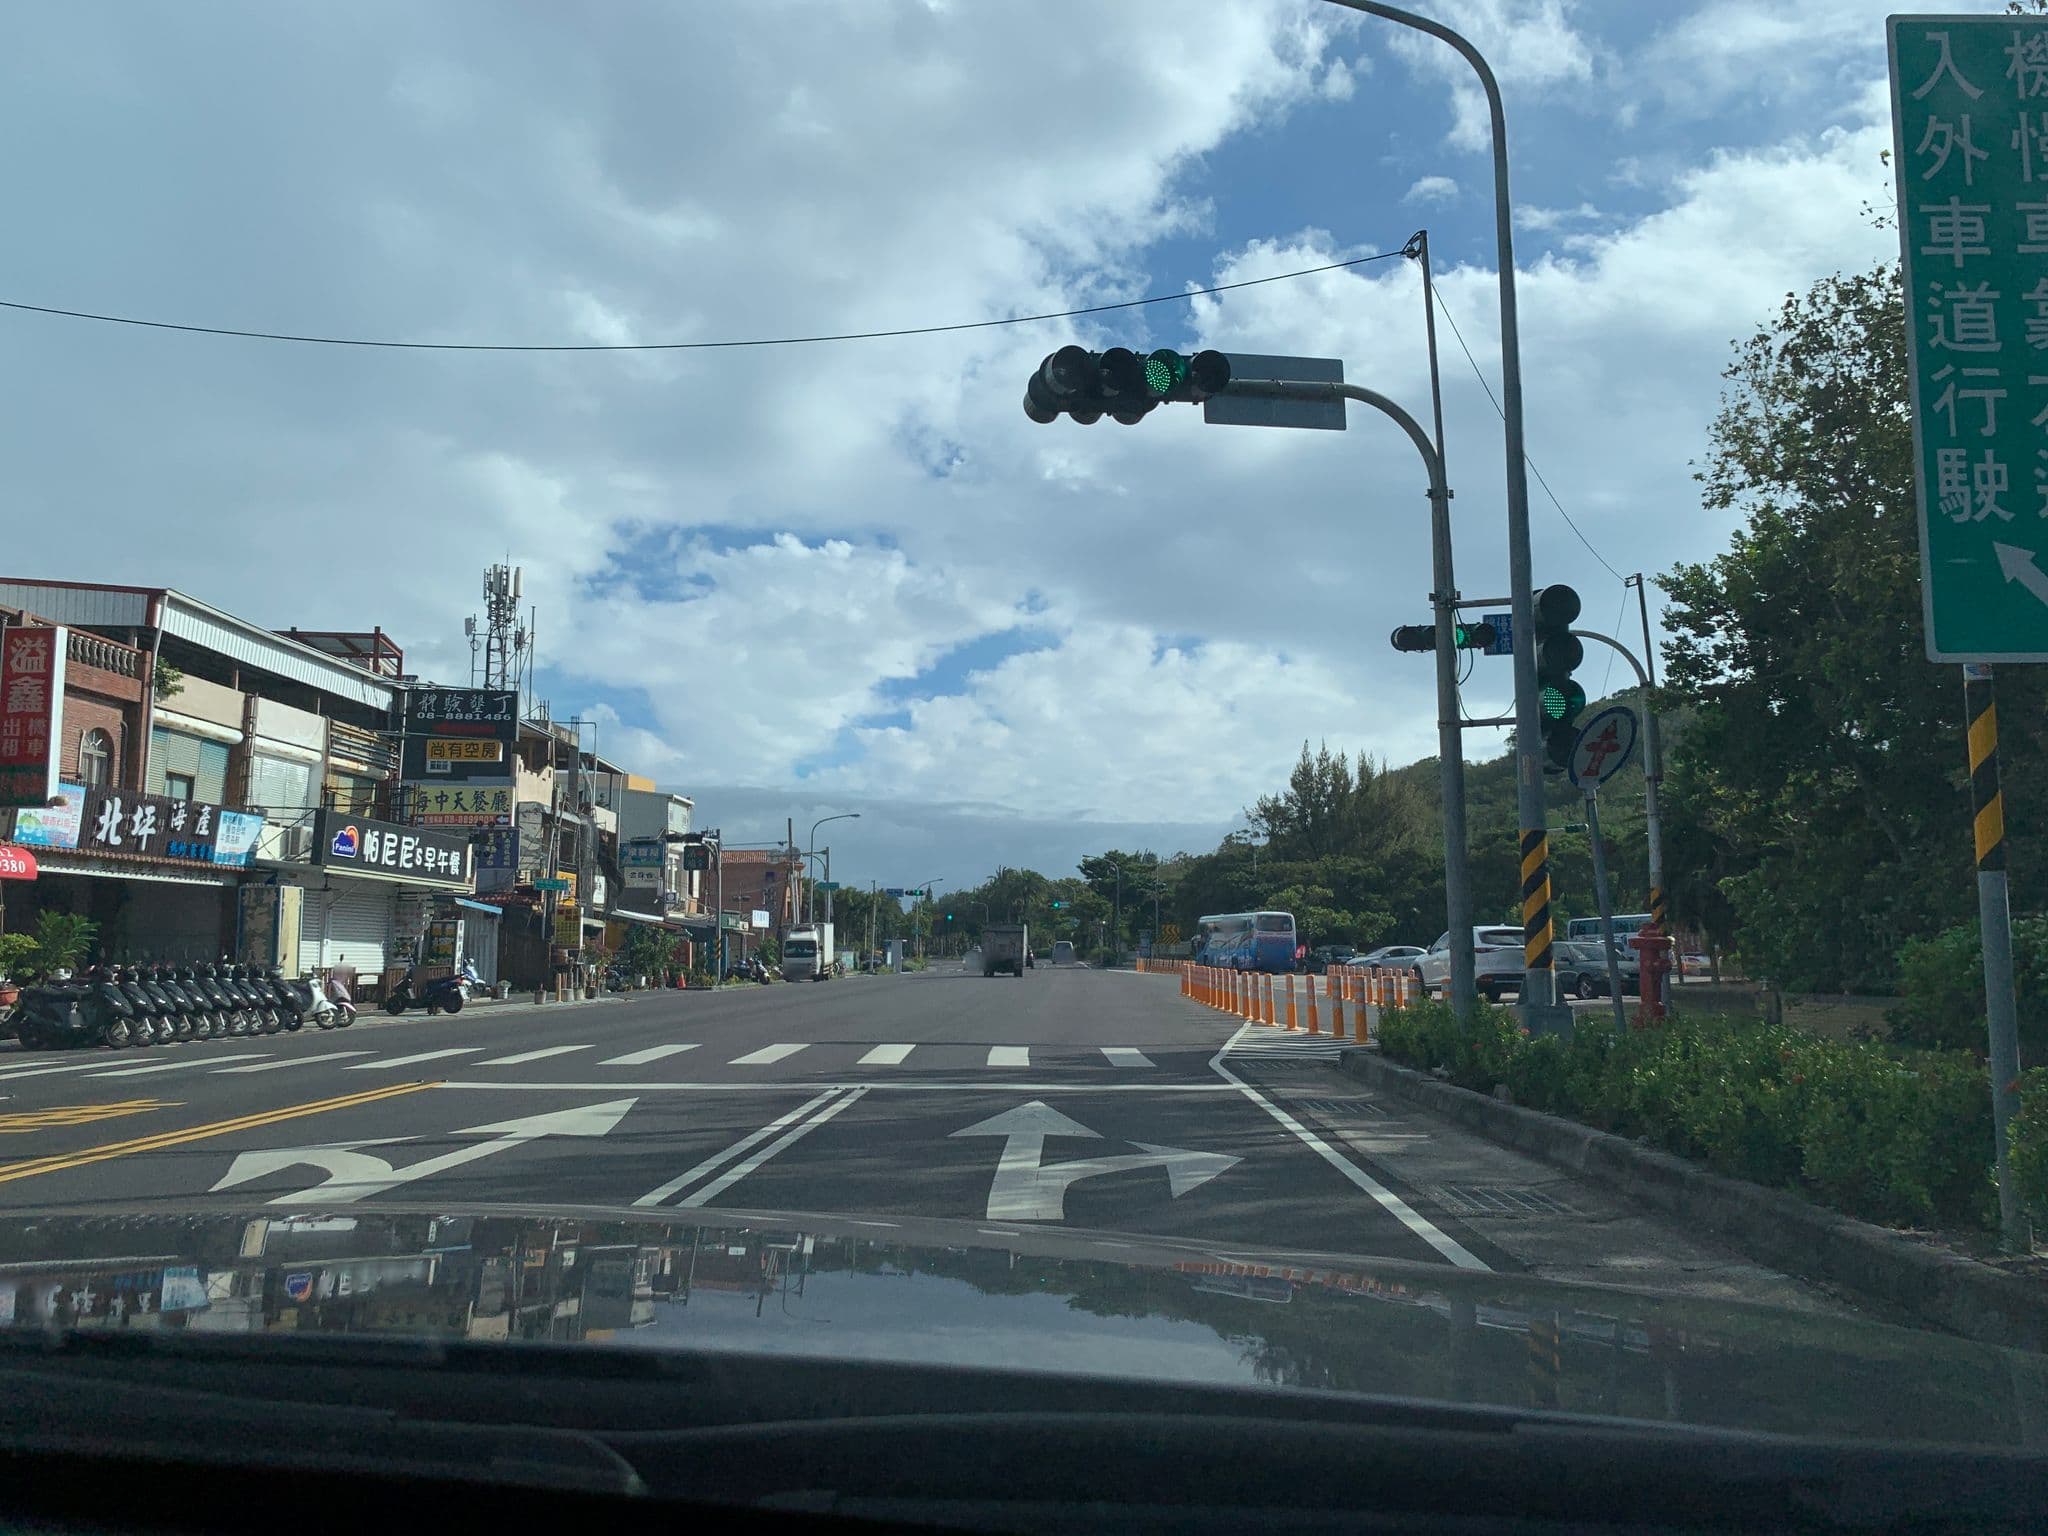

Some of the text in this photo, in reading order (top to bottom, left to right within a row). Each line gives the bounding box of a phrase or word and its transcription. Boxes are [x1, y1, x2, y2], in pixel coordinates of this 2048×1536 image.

[1912, 31, 2016, 523] 入外車道行駛
[7, 637, 48, 714] 溢鑫
[430, 741, 497, 758] 尚有空房
